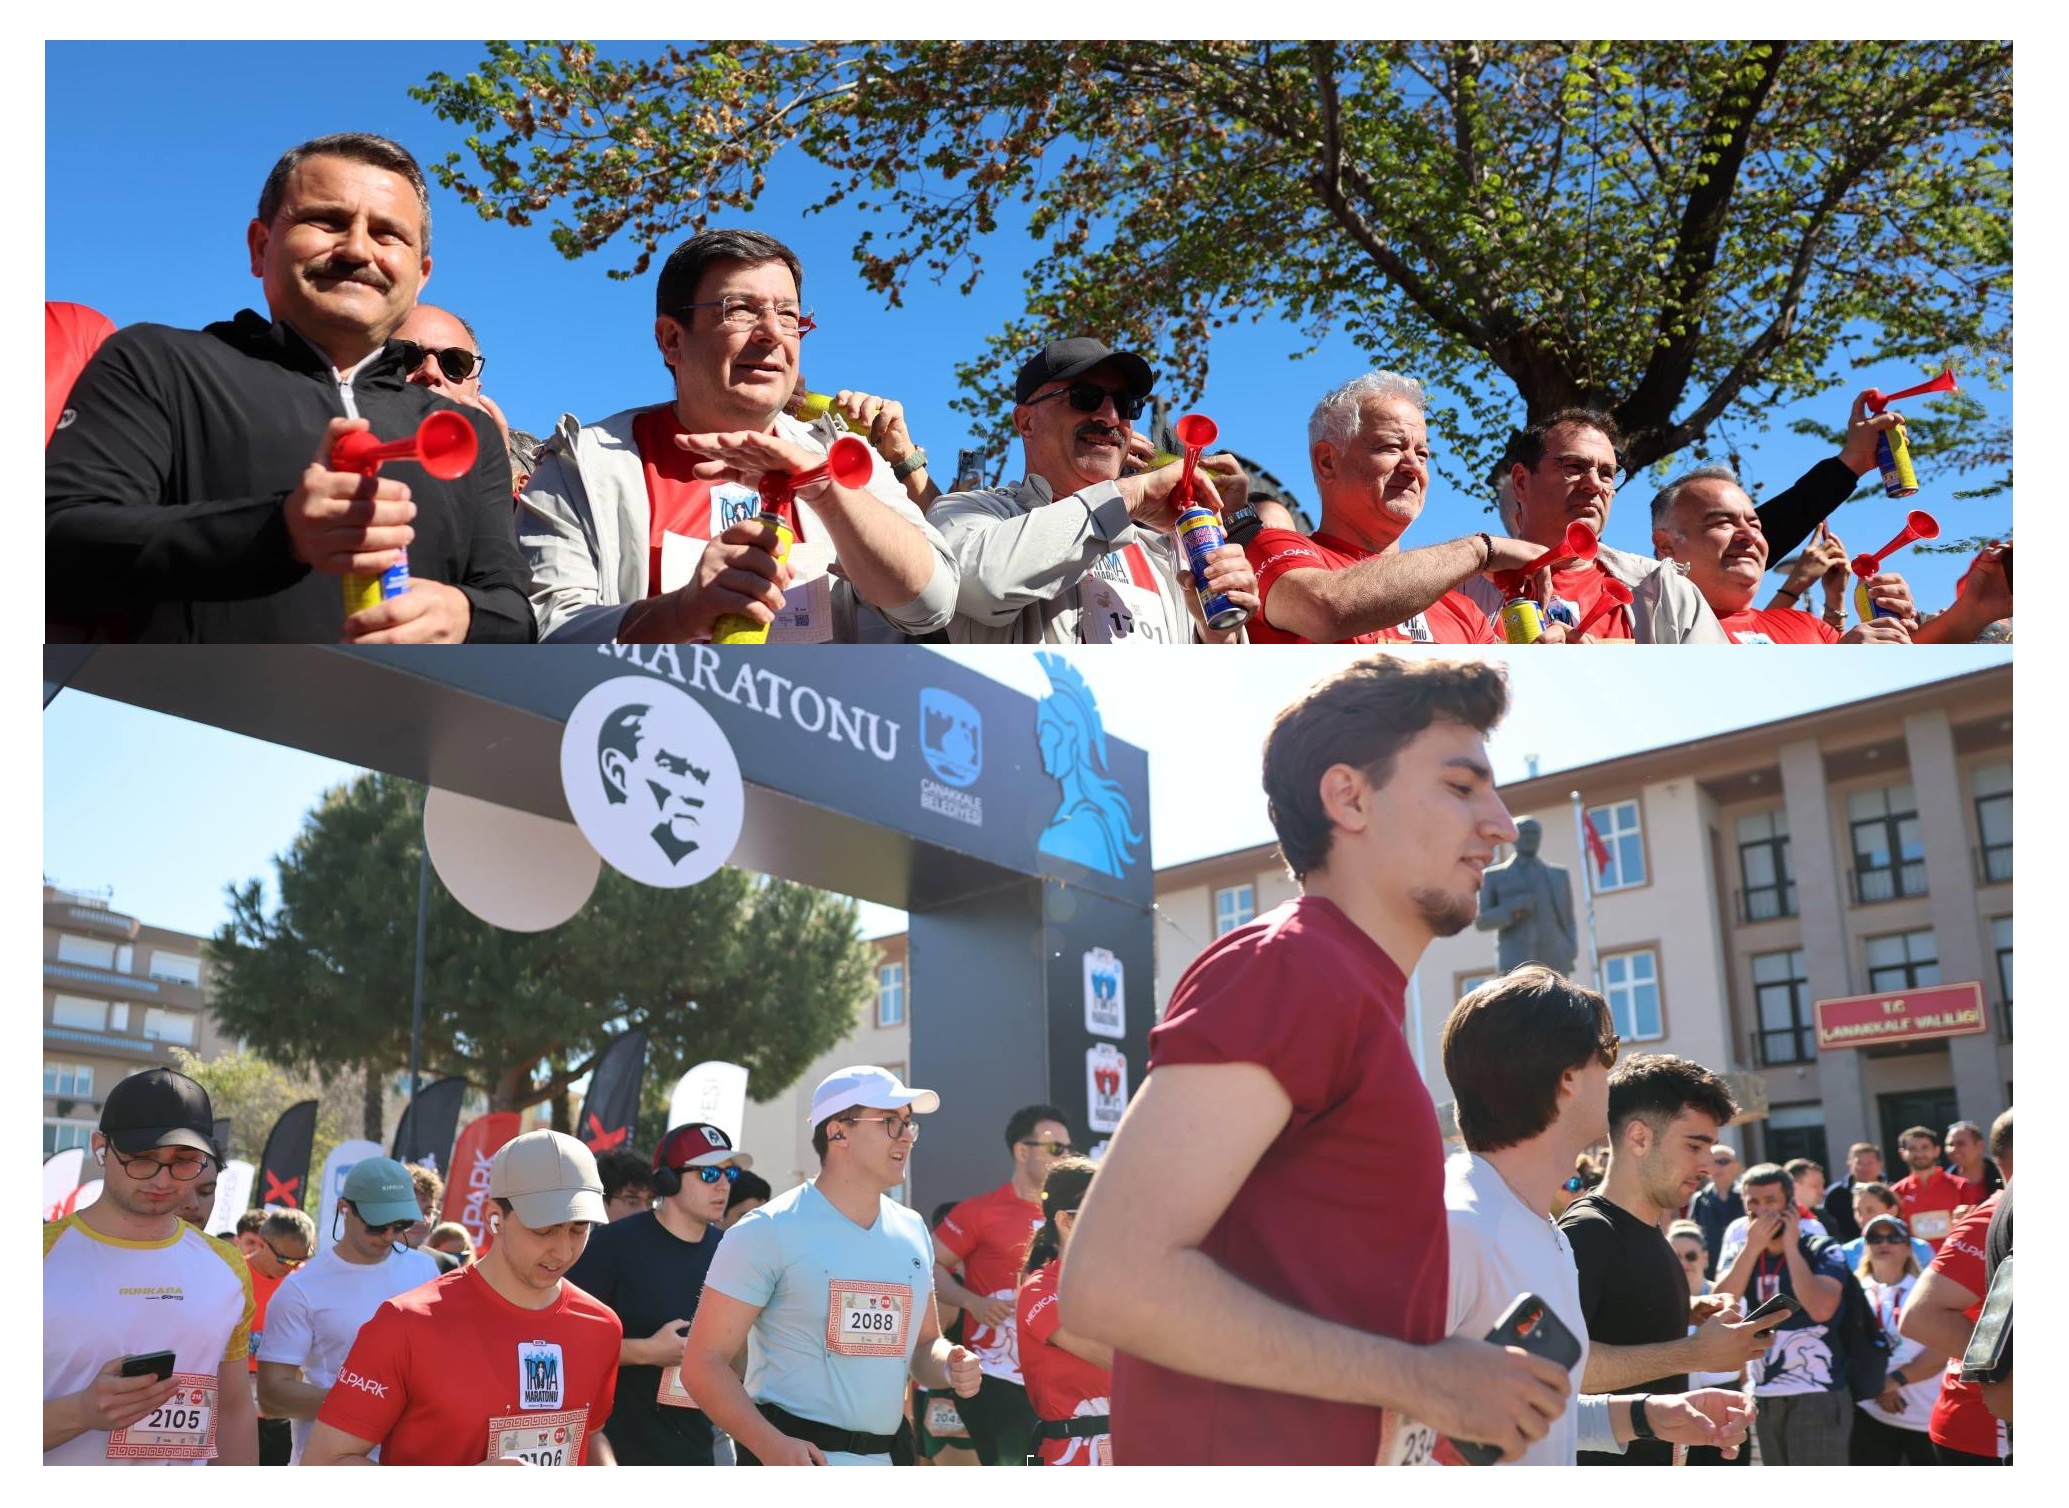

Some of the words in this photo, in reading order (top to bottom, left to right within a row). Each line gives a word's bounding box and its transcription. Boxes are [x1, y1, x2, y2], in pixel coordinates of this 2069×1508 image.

[852, 1312, 893, 1331] 2088
[524, 1390, 559, 1403] MARATONU
[148, 1409, 200, 1429] 2105
